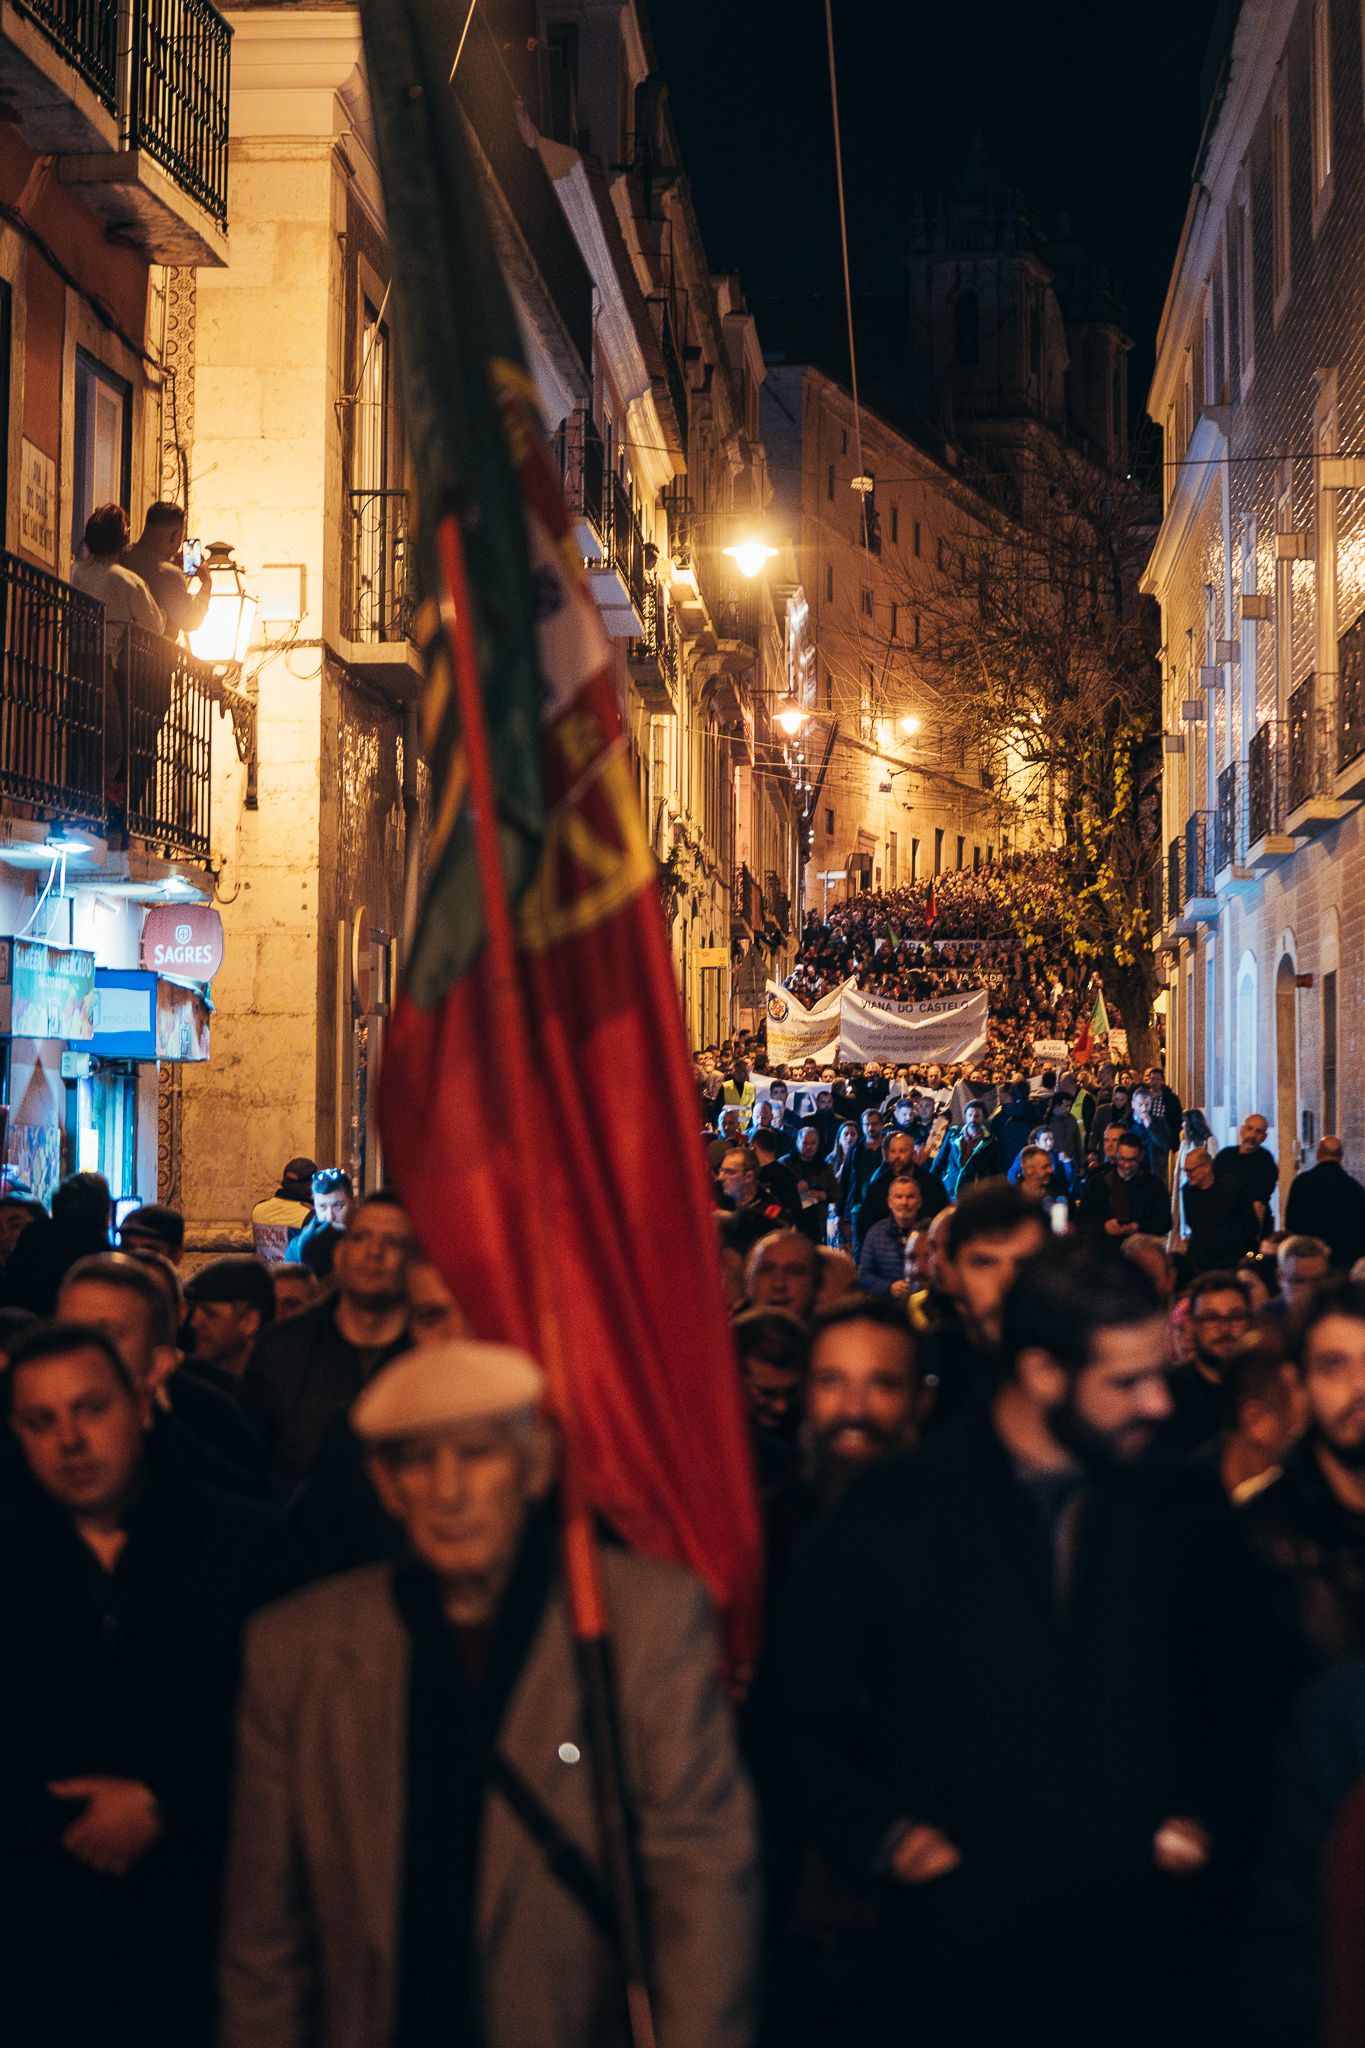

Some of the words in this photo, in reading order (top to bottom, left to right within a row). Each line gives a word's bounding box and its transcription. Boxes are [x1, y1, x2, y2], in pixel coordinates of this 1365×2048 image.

[154, 944, 213, 964] SAGRES
[862, 1000, 892, 1012] VIANA
[919, 1000, 969, 1014] CASTELO
